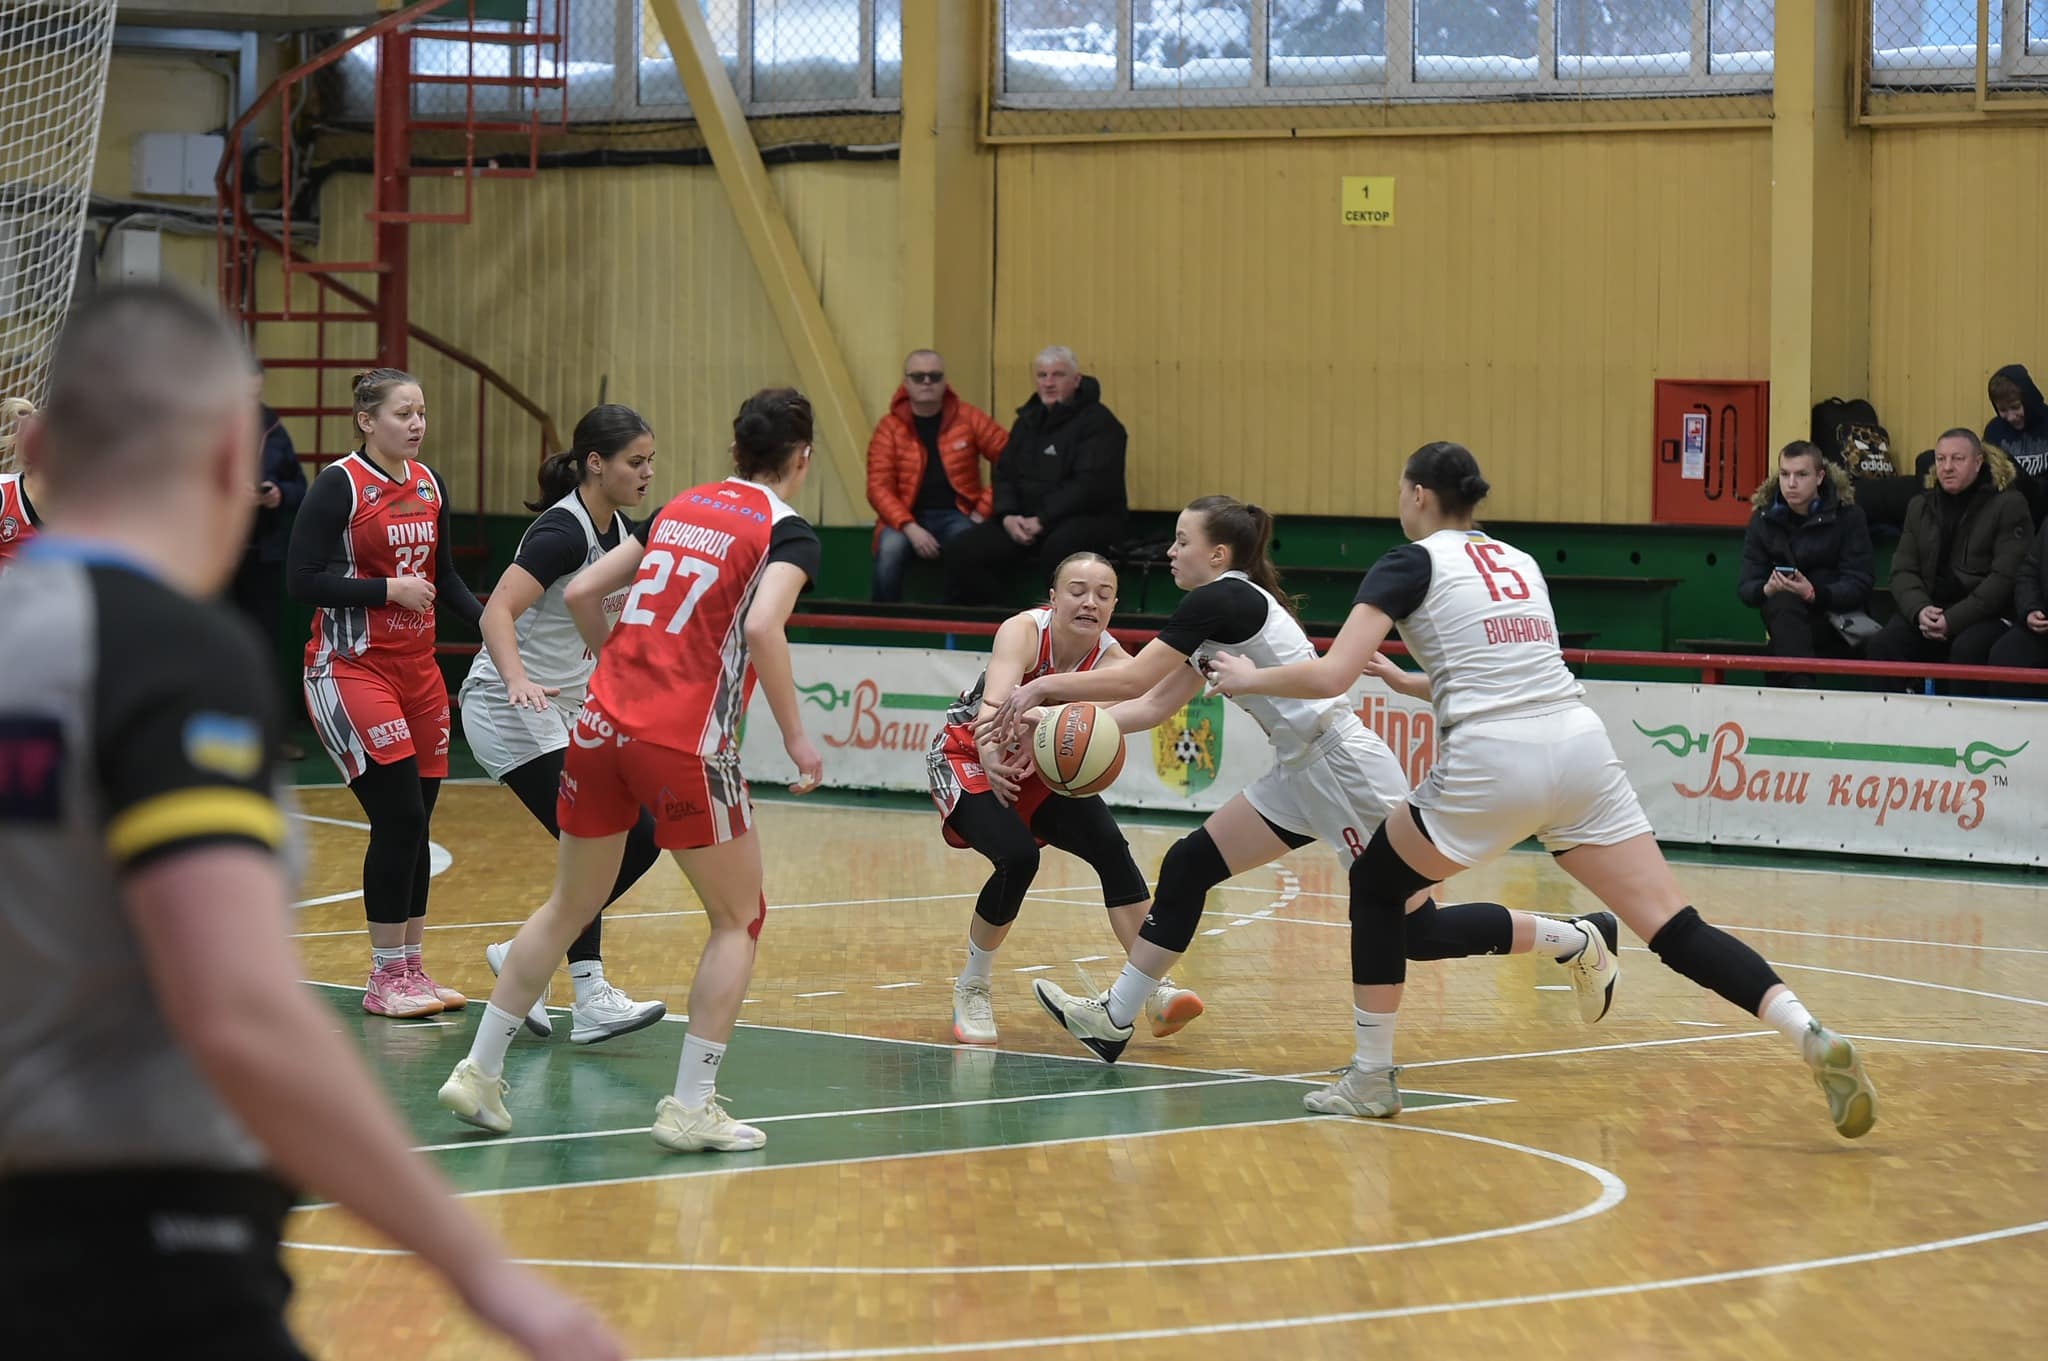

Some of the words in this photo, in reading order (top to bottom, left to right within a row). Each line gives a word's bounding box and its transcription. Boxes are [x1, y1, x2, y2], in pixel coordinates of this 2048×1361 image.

[1361, 184, 1369, 200] 1
[1345, 210, 1390, 221] СЕКТОР
[1860, 460, 1893, 473] adidas
[690, 494, 767, 523] EPSILON
[387, 521, 435, 546] RIVNE
[653, 519, 736, 561] HRYHORUK
[395, 545, 430, 578] 22
[1464, 542, 1530, 601] 15
[620, 549, 719, 635] 27
[1483, 617, 1554, 645] BUHAIOVA
[823, 678, 929, 752] Ваш
[1672, 721, 1811, 801] Ваш
[1826, 773, 1988, 831] карниз
